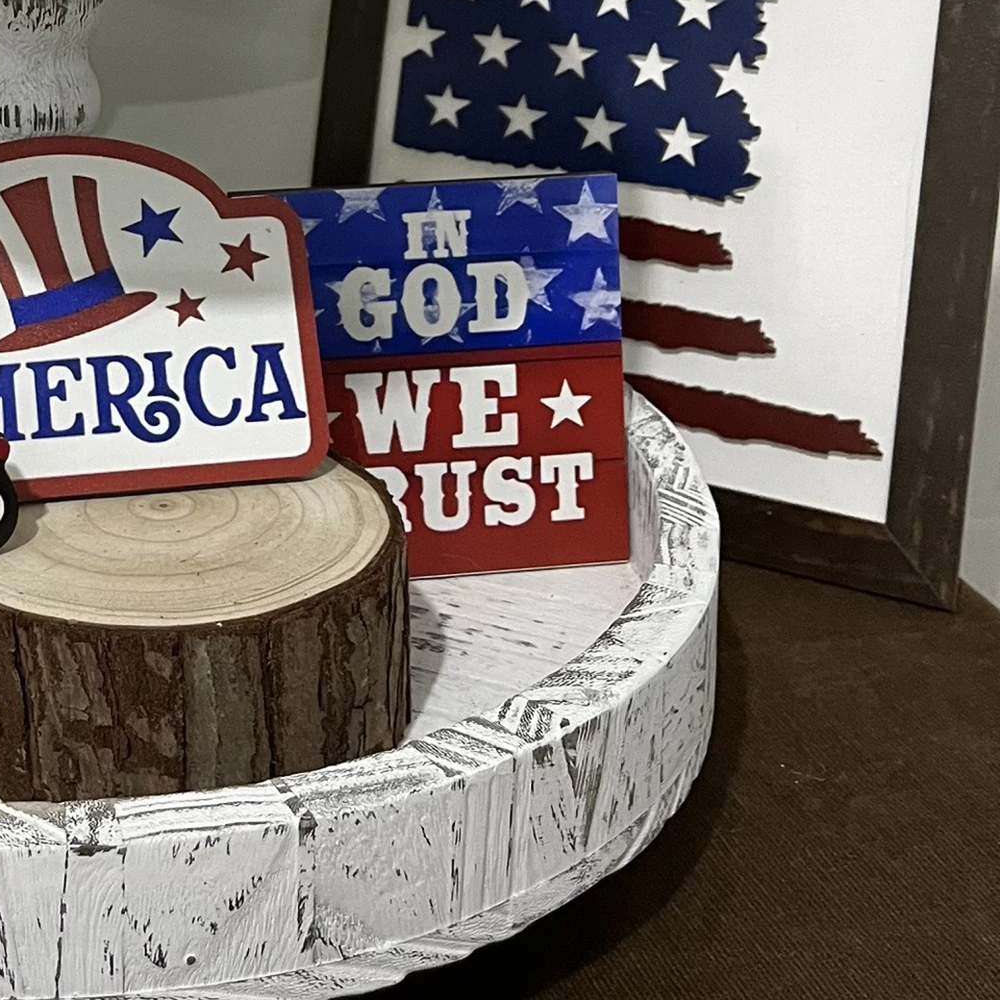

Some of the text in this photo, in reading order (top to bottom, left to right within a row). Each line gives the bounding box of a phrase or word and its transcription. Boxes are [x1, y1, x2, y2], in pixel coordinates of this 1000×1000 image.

[402, 209, 472, 260] IN
[336, 260, 530, 342] GOD
[344, 363, 519, 455] WE
[363, 451, 594, 533] RUST
